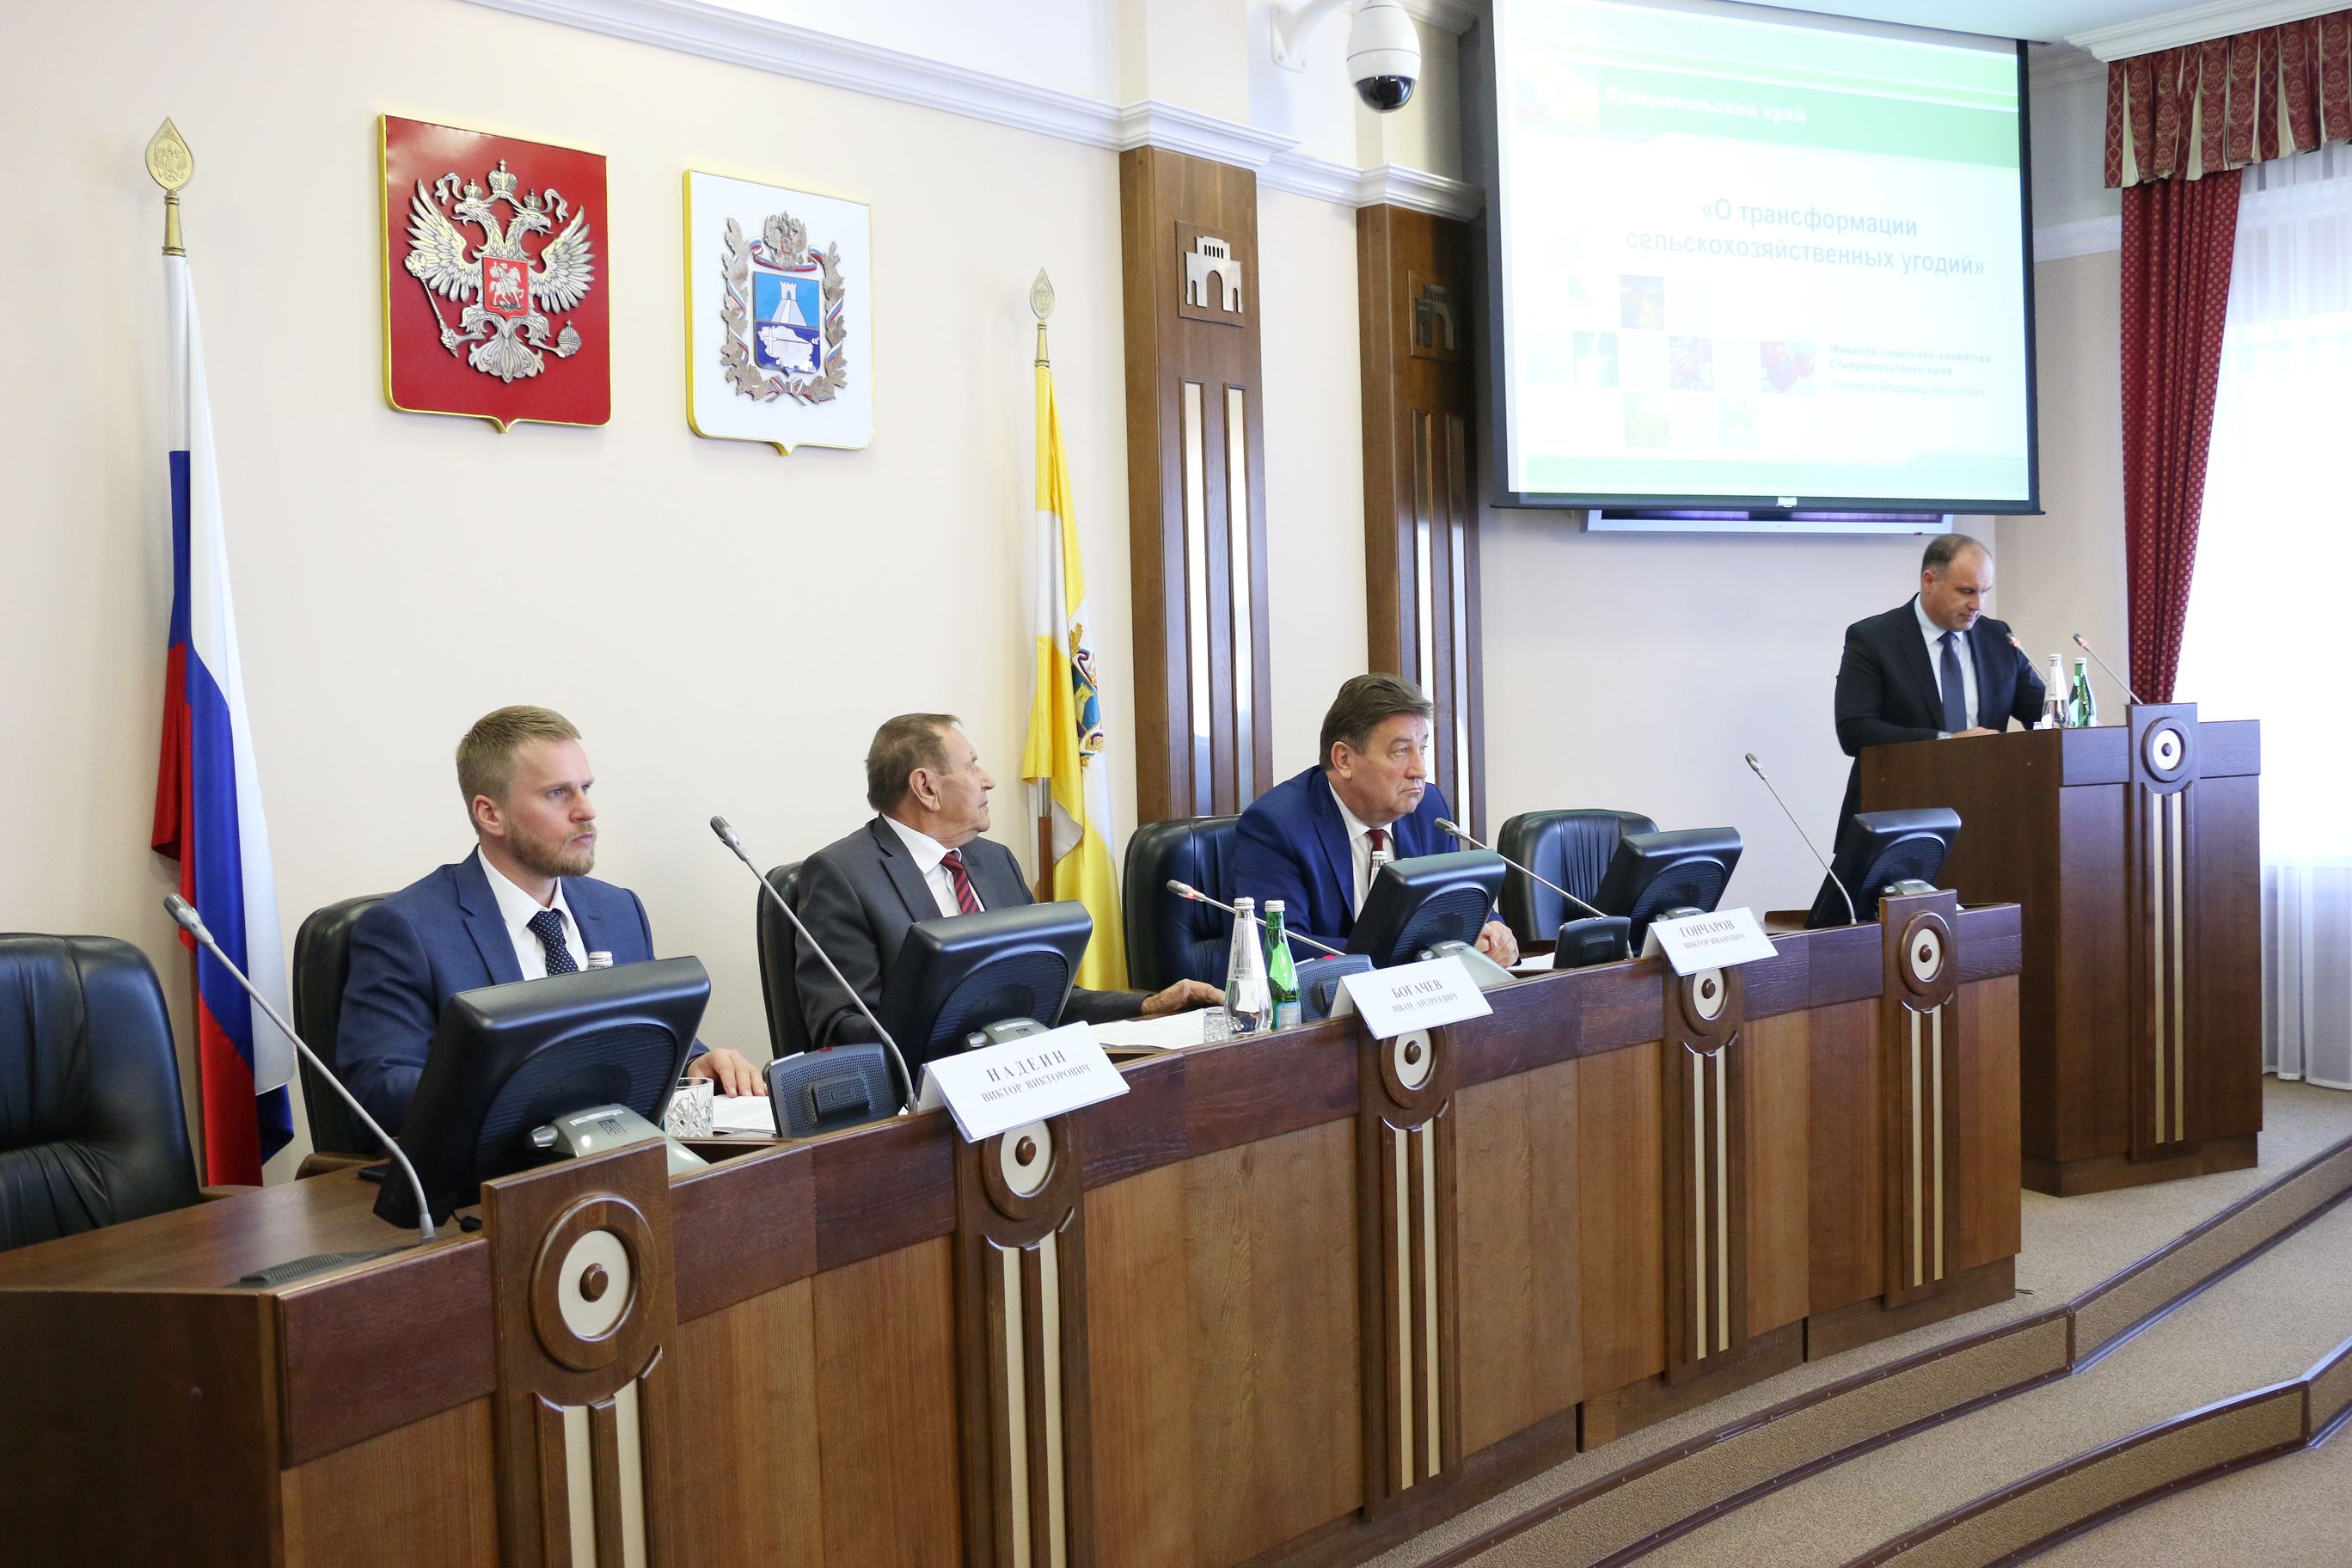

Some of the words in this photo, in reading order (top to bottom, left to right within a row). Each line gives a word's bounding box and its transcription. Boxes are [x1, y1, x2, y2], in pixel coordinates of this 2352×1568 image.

[1605, 85, 1757, 119] Ставропольский
[1763, 107, 1806, 124] край
[1701, 198, 1732, 220] «О
[1738, 205, 1918, 237] трансформации
[1626, 230, 1895, 269] сельскохозяйственных
[1901, 252, 1986, 276] угодий»
[1829, 345, 1877, 358] Министр
[1679, 920, 1735, 937] ГОНЧАРОВ
[1683, 940, 1710, 949] ВИКТОР
[1710, 934, 1745, 945] ИВАНОВИЧ
[1391, 980, 1442, 998] БОГАЧЕВ
[1391, 1002, 1413, 1013] ИВАН
[1417, 994, 1458, 1008] АНДРЕЕВИЧ
[986, 1050, 1067, 1082] НАДЕИН
[981, 1083, 1023, 1103] ВИКТОР
[1026, 1064, 1091, 1089] ВИКТОРОВИЧ
